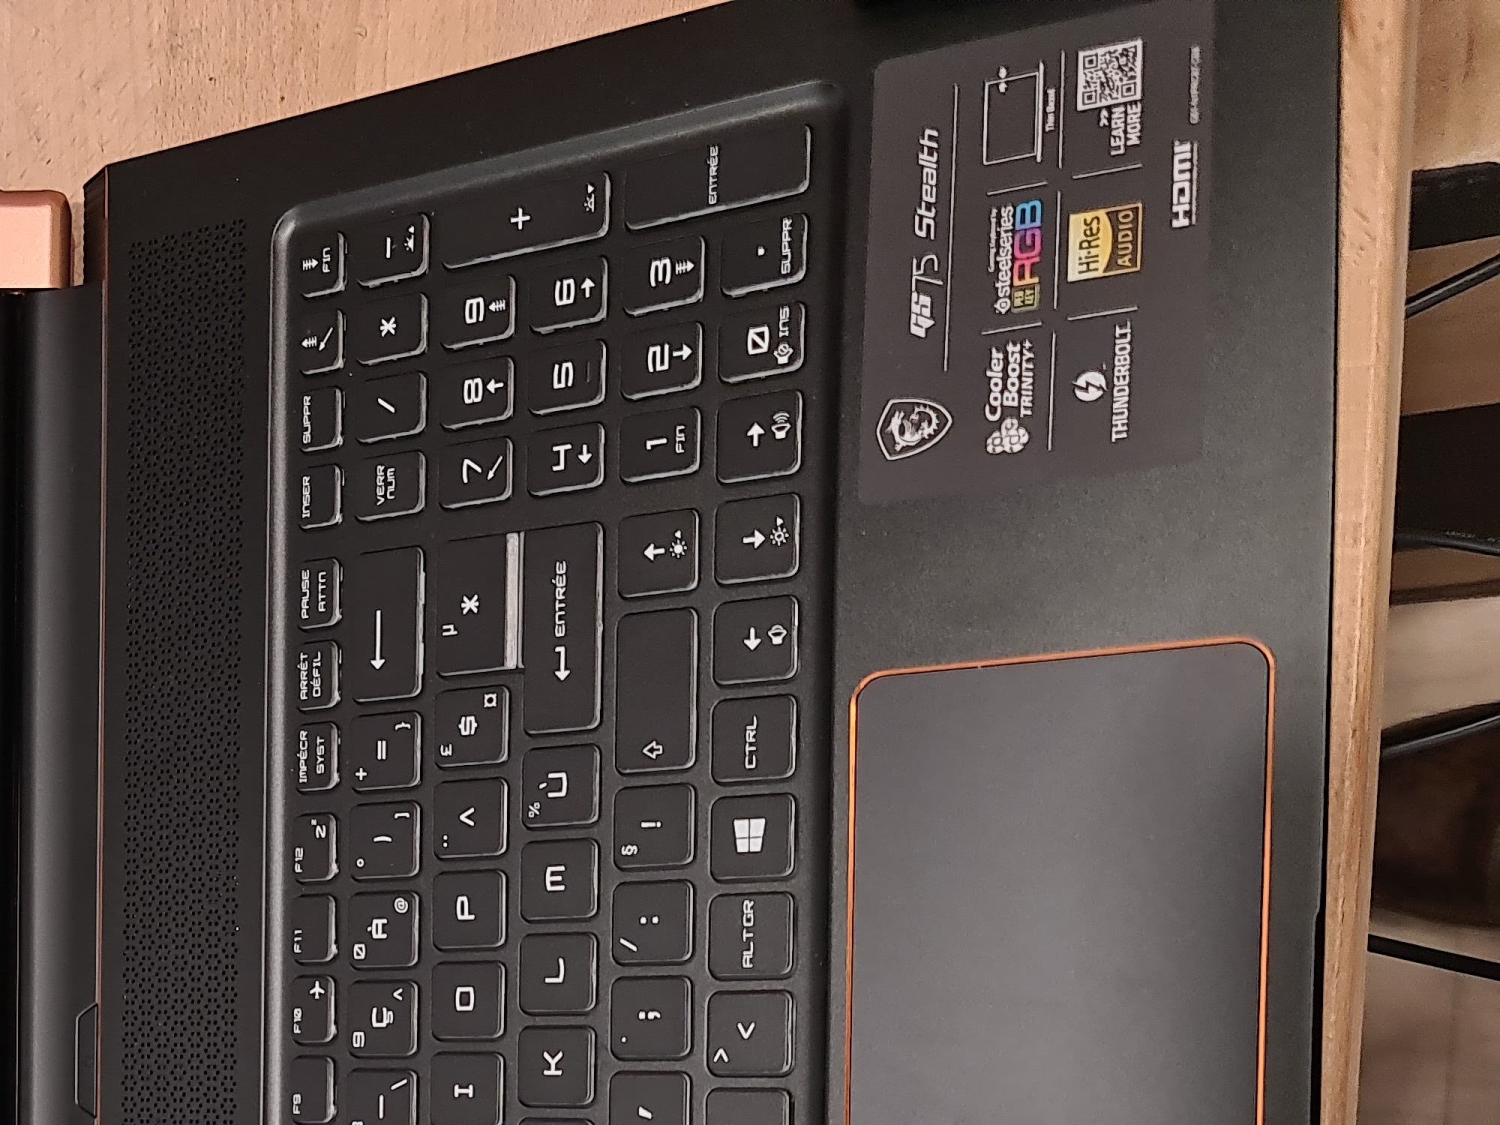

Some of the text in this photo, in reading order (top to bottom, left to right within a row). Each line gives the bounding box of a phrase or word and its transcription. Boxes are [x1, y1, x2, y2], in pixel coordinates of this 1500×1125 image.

[1110, 107, 1125, 155] LEARN
[1127, 101, 1142, 144] MORE
[708, 146, 718, 204] ENTRÉE
[914, 128, 940, 241] Stealth
[1172, 140, 1191, 228] HDMI
[781, 219, 792, 274] SUPPR
[996, 205, 1013, 297] steelseries
[1013, 200, 1042, 284] RGB
[1078, 216, 1100, 275] Hi-Res
[1117, 210, 1135, 267] AUDIO
[650, 258, 671, 286] 3
[555, 279, 574, 306] 6
[465, 297, 484, 323] 9
[779, 306, 789, 337] INS
[748, 326, 769, 354] 0
[648, 344, 669, 372] 2
[554, 362, 573, 388] 5
[985, 348, 1004, 421] Cooler
[1003, 340, 1020, 407] Boost
[1020, 339, 1034, 417] TRINITY+
[1110, 323, 1133, 442] THUNDERBOLT
[464, 378, 482, 403] 8
[647, 438, 667, 449] 1
[676, 426, 685, 453] FIN
[463, 459, 481, 483] 7
[553, 444, 571, 471] 4
[302, 477, 310, 518] INSER
[387, 468, 395, 499] NUM
[552, 561, 566, 637] ENTRÉE
[297, 653, 307, 699] ARRÊT
[310, 652, 320, 697] DÉFIL
[459, 716, 477, 735] $
[745, 716, 757, 768] CTRL
[297, 731, 307, 783] IMPÉCR
[540, 773, 567, 797] Ù
[295, 848, 303, 872] F12
[395, 898, 408, 913] @
[457, 896, 475, 919] P
[294, 930, 302, 952] F11
[368, 919, 387, 938] À
[545, 958, 564, 982] L
[456, 987, 474, 1011] O
[372, 1008, 393, 1027] Ç
[353, 1032, 364, 1047] 9
[544, 1052, 562, 1075] K
[293, 1094, 301, 1114] F9
[455, 1085, 473, 1097] I
